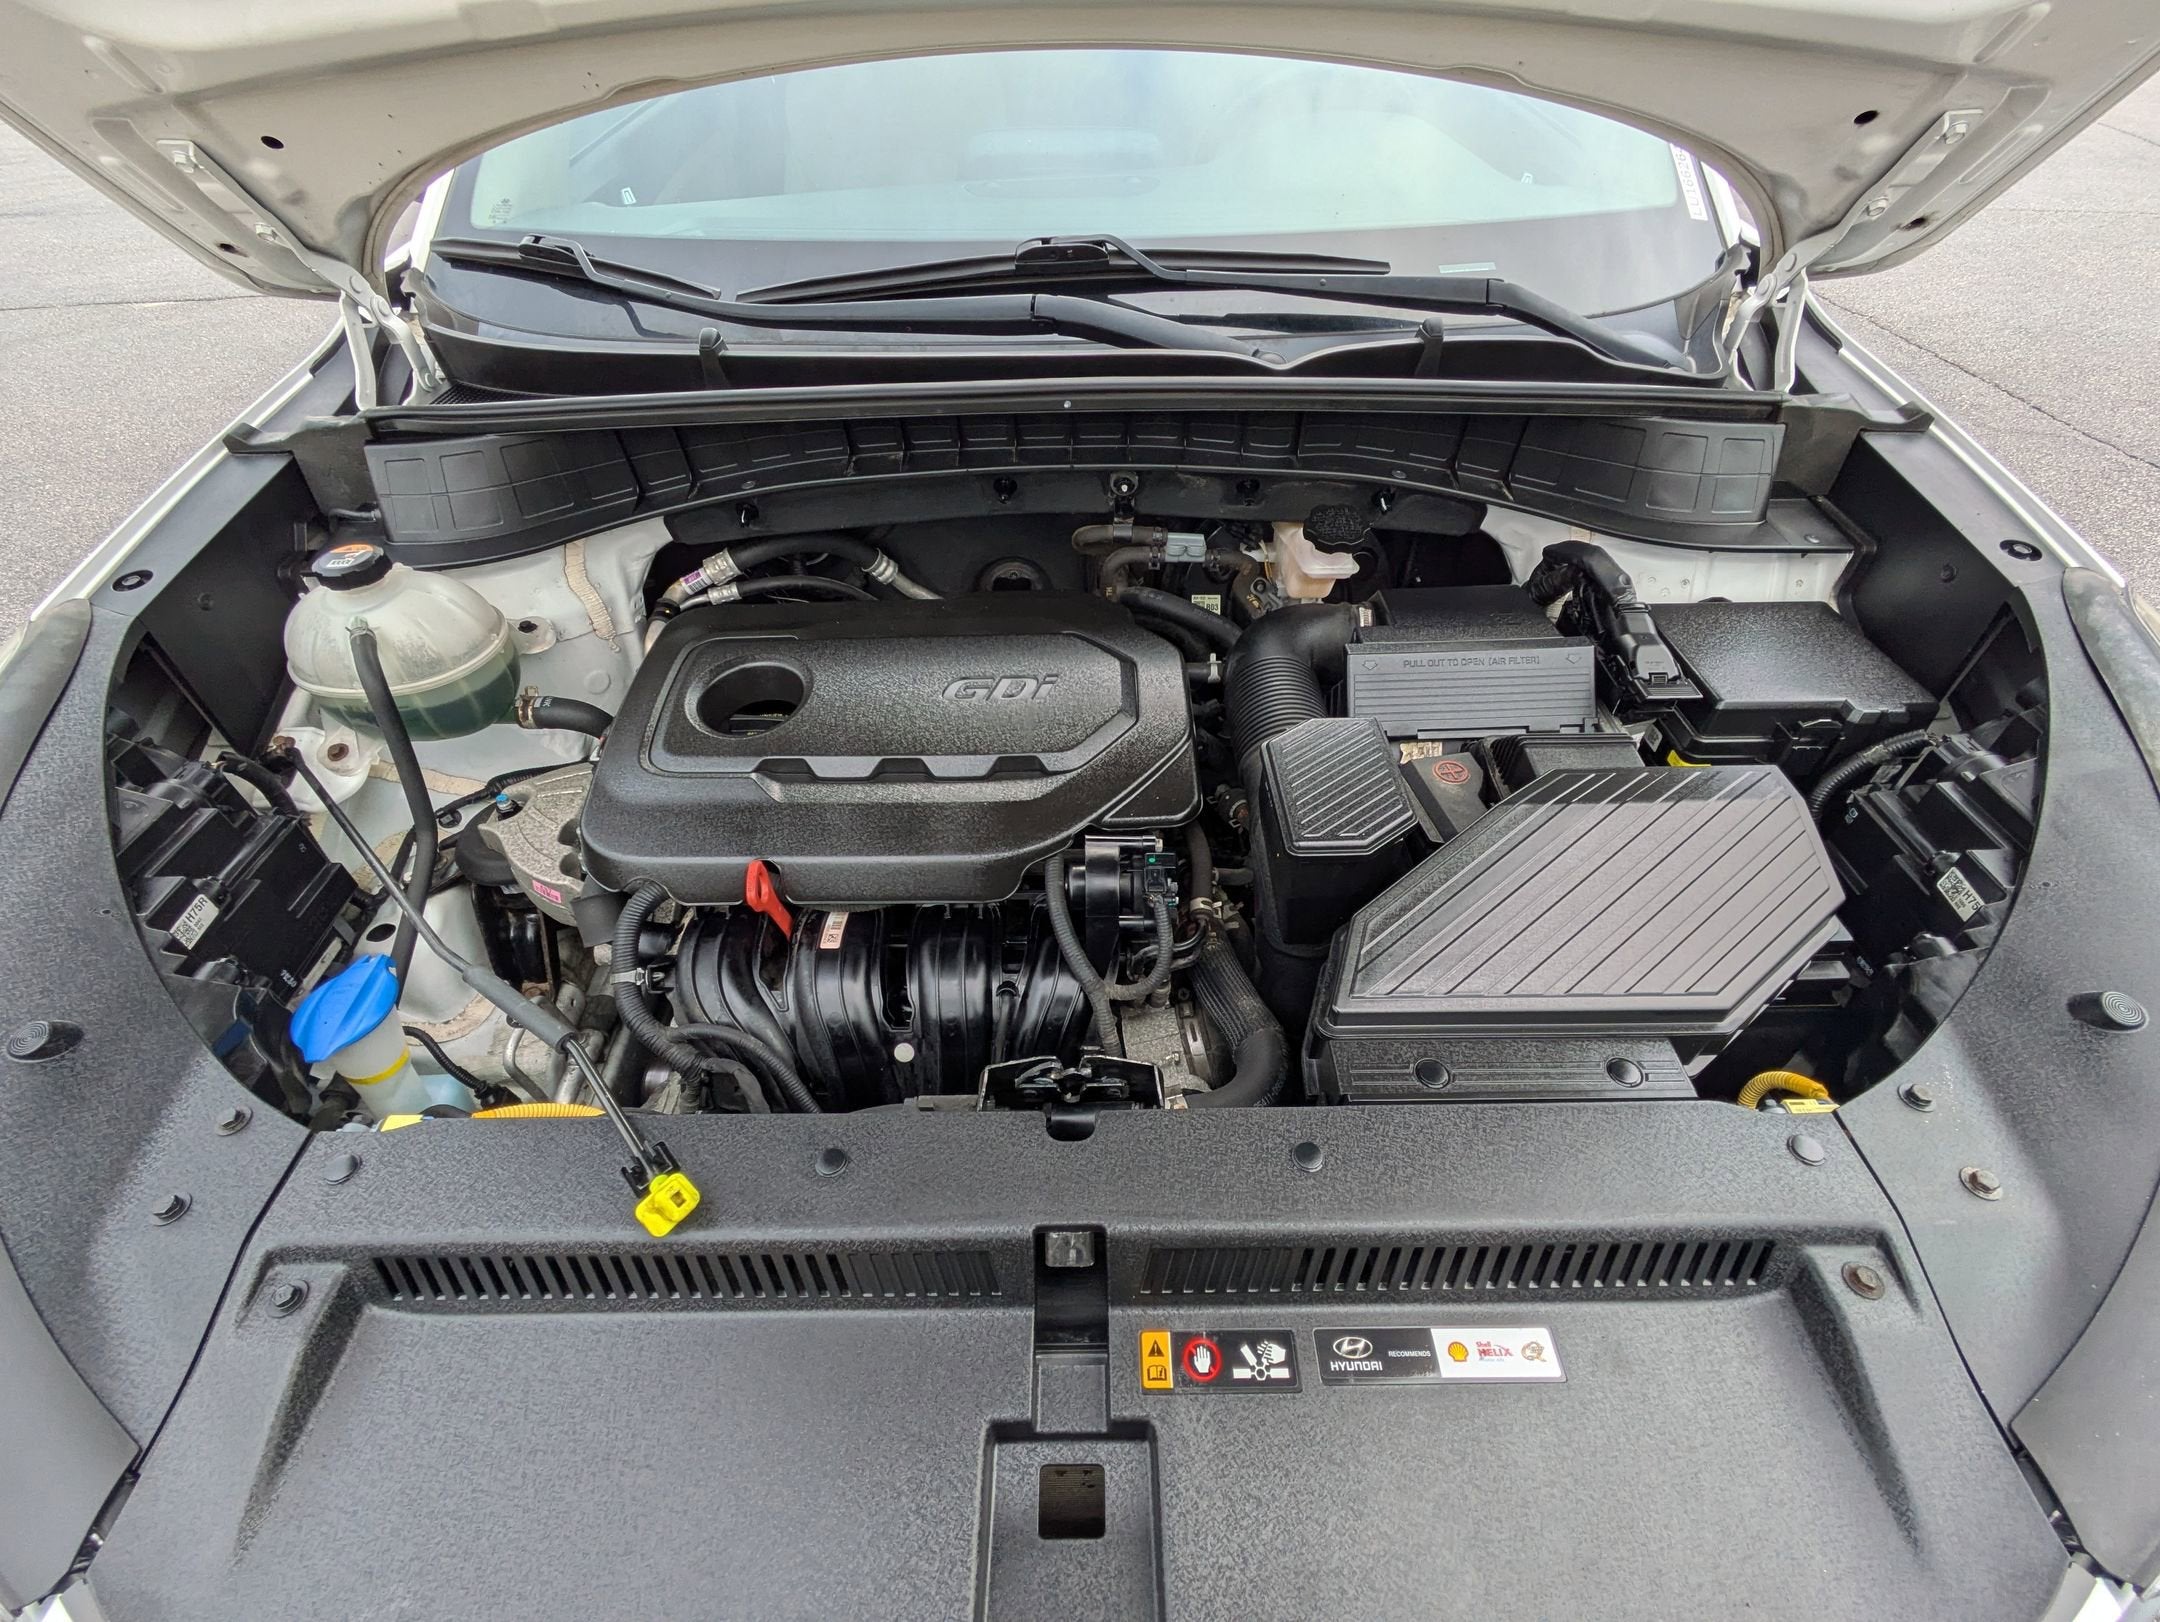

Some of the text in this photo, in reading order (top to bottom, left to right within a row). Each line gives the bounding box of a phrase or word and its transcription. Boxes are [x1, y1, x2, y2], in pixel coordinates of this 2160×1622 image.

[1675, 149, 1703, 217] LU16626
[1403, 659, 1426, 668] PULL
[1427, 658, 1445, 667] OUT
[1447, 658, 1459, 667] TO
[1461, 657, 1485, 666] OPEN
[941, 673, 1059, 701] GDi
[185, 897, 208, 923] H75R
[1388, 1350, 1432, 1358] RECOMMENDS
[1477, 1347, 1514, 1357] HELIX
[1330, 1361, 1383, 1371] HYUNDAI
